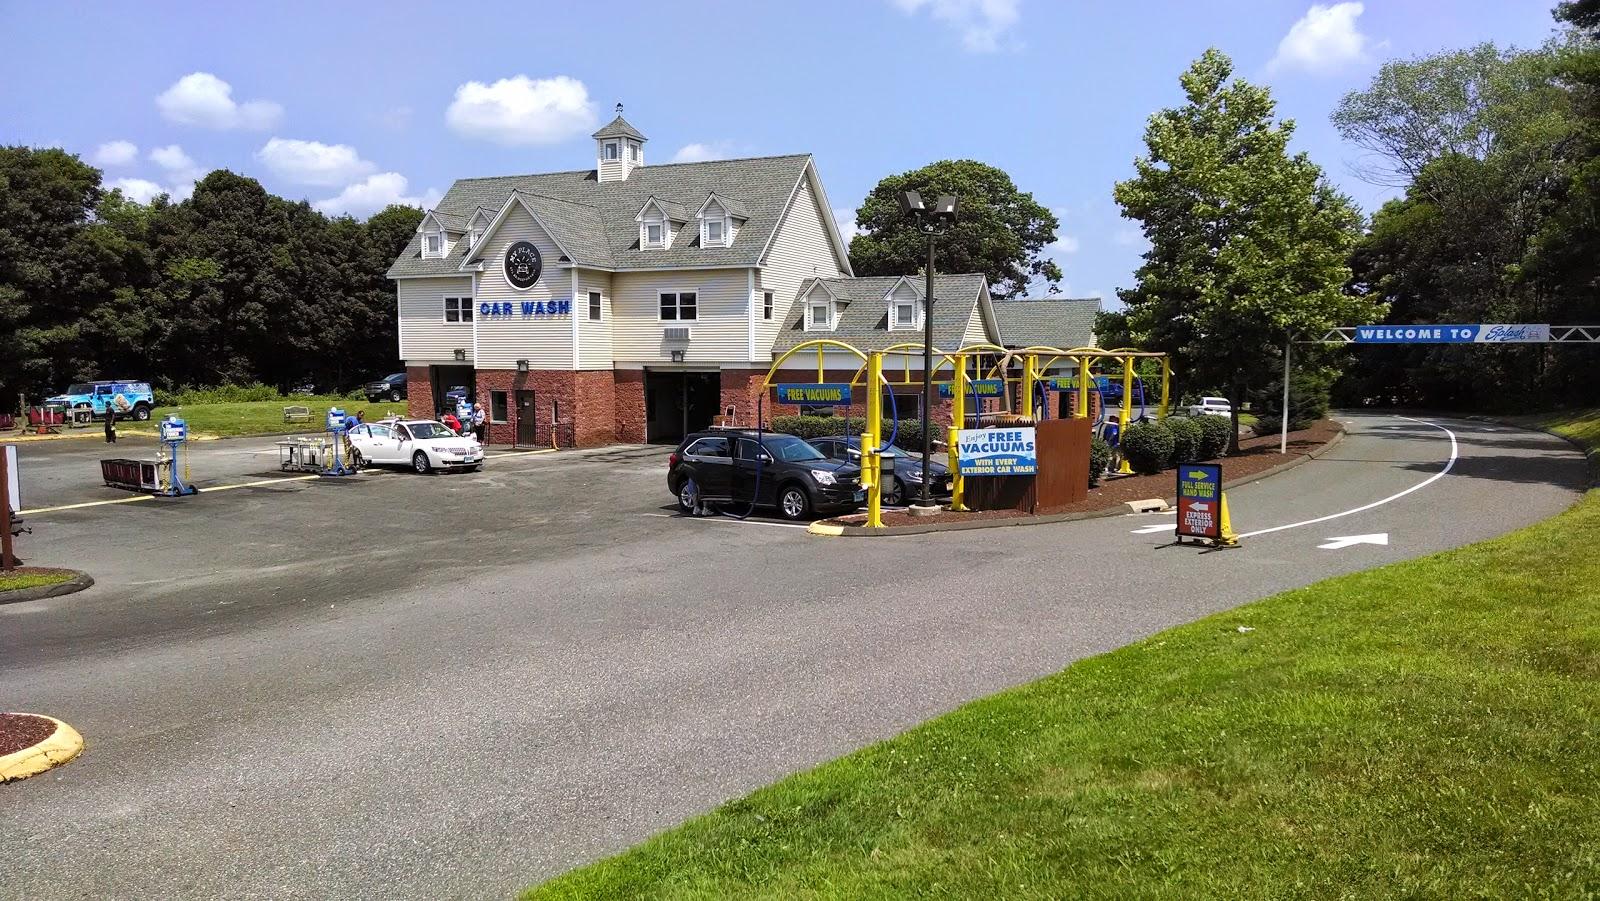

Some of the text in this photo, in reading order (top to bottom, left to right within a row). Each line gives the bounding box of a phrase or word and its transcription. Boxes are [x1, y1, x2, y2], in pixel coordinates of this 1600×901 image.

[518, 246, 537, 263] PLACE
[480, 300, 569, 315] CAR WASH
[1360, 325, 1527, 341] WELCOME TO Splash
[1057, 378, 1071, 389] FREE
[787, 388, 842, 401] FREE VACUUMS
[965, 431, 1022, 443] Enjoy FREE
[960, 442, 1034, 453] VACUUMS
[975, 458, 1018, 466] WITH EVERY
[961, 466, 995, 474] EXTERIOR
[1013, 465, 1035, 473] WASH
[1182, 481, 1215, 490] FULL SERVICE
[1183, 488, 1214, 498] HAND WASH
[1186, 511, 1212, 520] EXPRESS
[1184, 518, 1213, 528] EXTERIOR
[1190, 526, 1207, 534] ONLY
